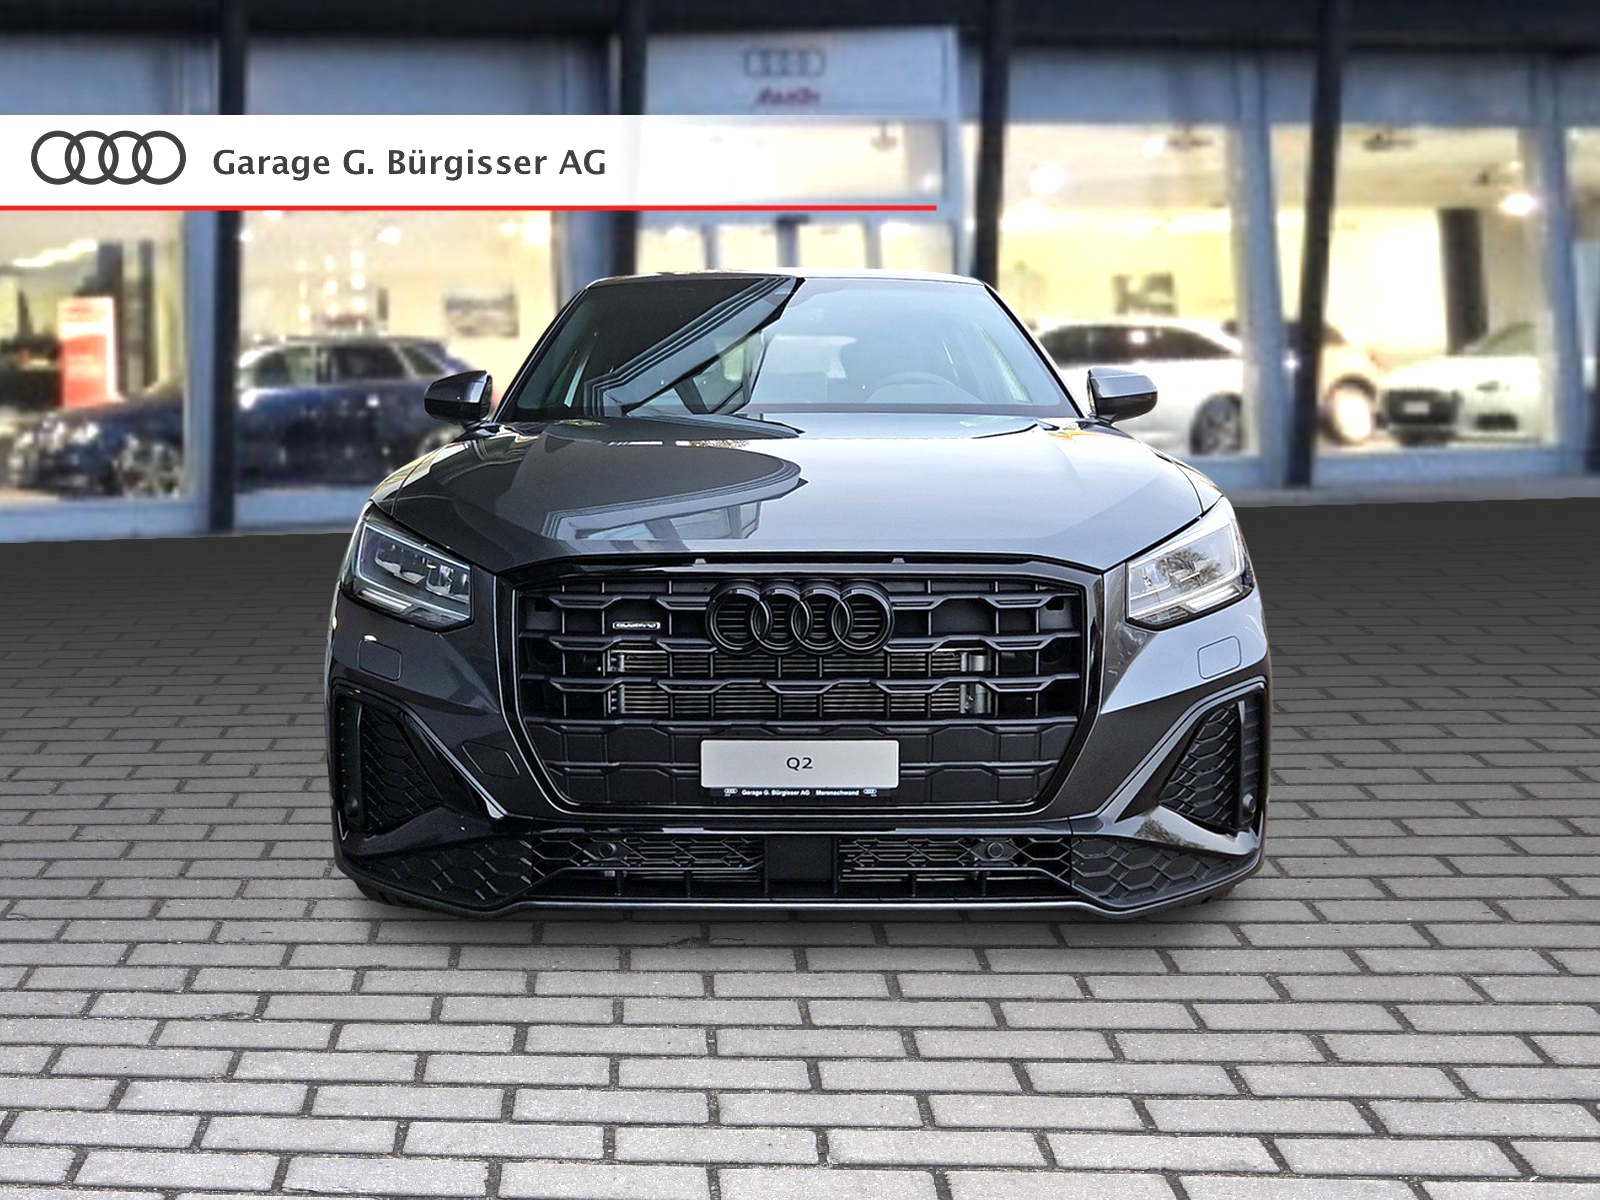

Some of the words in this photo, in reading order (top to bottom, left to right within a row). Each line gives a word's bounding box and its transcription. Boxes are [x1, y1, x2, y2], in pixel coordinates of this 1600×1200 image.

[786, 757, 813, 771] Q2
[741, 789, 763, 797] Garage
[771, 788, 800, 797] Bürgisser
